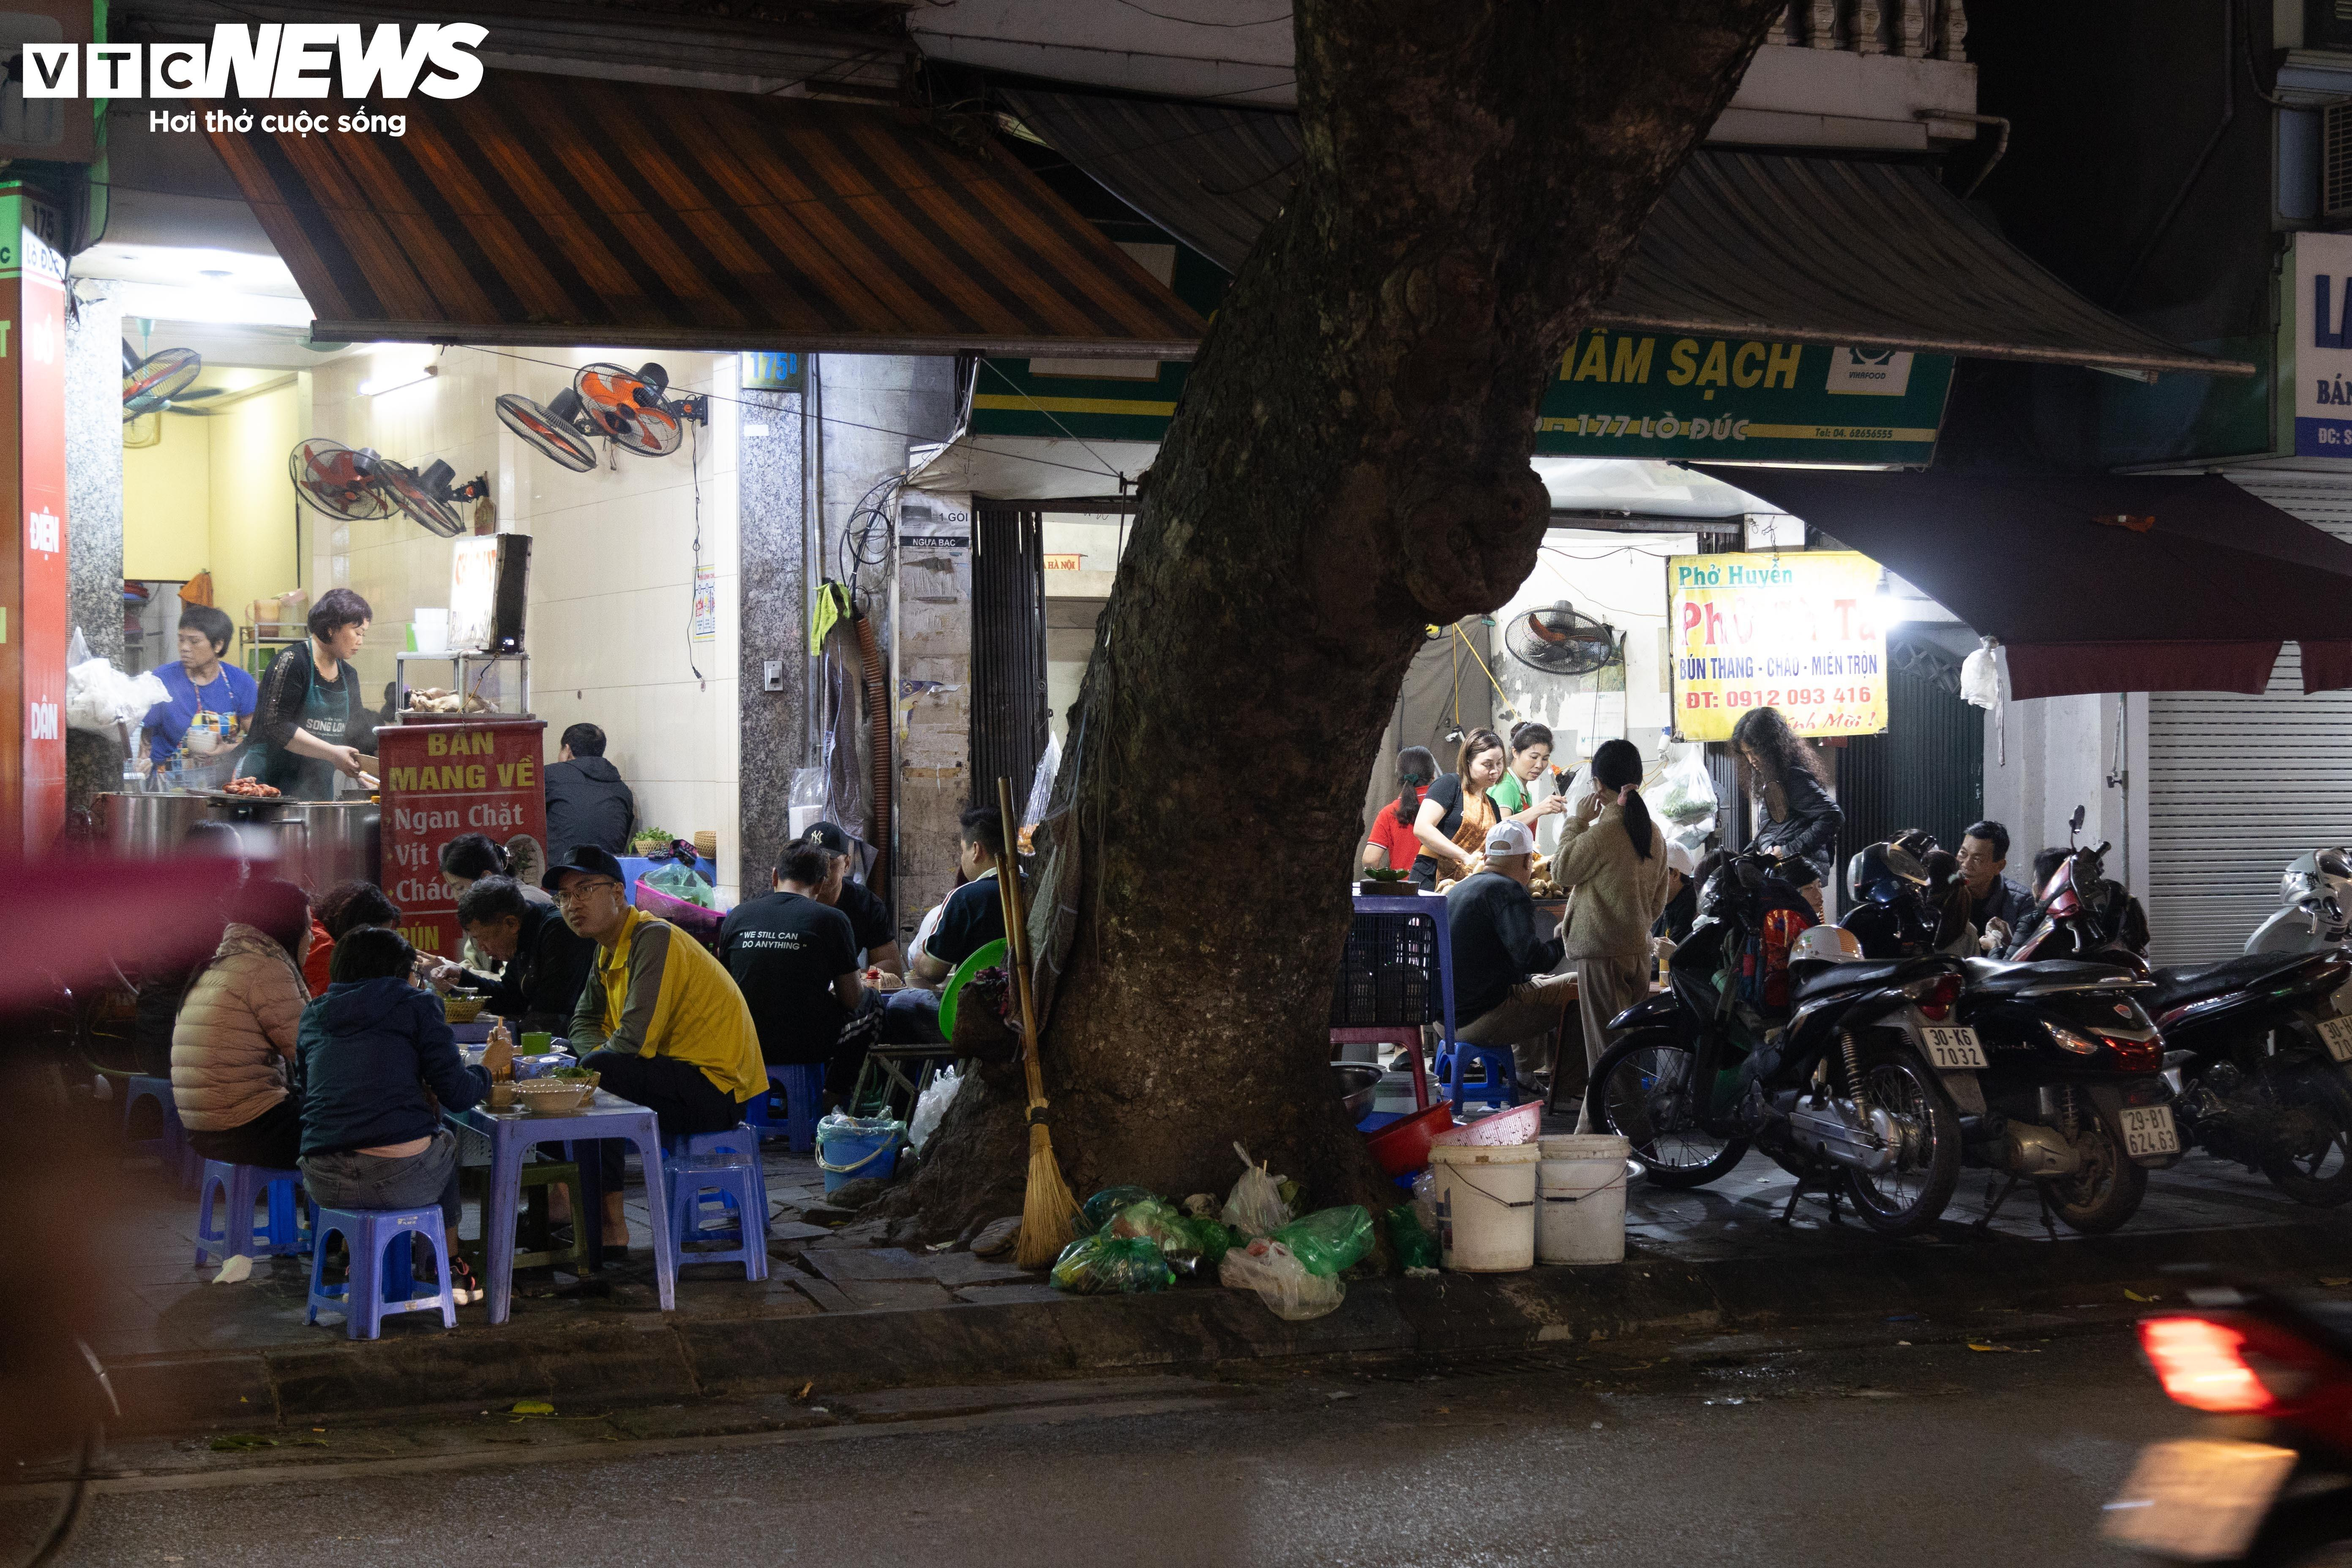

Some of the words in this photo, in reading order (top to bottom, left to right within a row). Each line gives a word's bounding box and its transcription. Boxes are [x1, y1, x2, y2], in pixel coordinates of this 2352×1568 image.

[1667, 338, 1803, 401] SẠCH
[1577, 414, 1632, 437] 177
[1640, 411, 1680, 439] LÒ
[948, 511, 968, 522] GÓI
[30, 507, 59, 560] ĐIỆN
[1048, 559, 1059, 569] HÀ
[1061, 559, 1075, 570] NỘI
[1678, 564, 1720, 586] Phở
[1728, 558, 1793, 589] Huyền
[1679, 654, 1706, 680] BÚN
[1711, 657, 1754, 679] THANG
[1847, 651, 1877, 679] TRỘN
[1686, 691, 1719, 709] ĐT:
[1726, 690, 1780, 707] 0912
[1787, 688, 1825, 705] 093
[1833, 687, 1871, 704] 416
[31, 695, 58, 741] DÂN
[389, 764, 486, 791] MANG
[496, 755, 535, 788] VỀ
[395, 808, 460, 834] Ngan
[468, 803, 524, 831] Chặt
[396, 843, 429, 871] Vịt
[755, 941, 800, 950] ANYTHING
[778, 932, 798, 940] CAN
[1930, 1029, 1972, 1046] 30-K6
[1936, 1048, 1980, 1065] 7032
[2128, 1109, 2166, 1130] 29-B1
